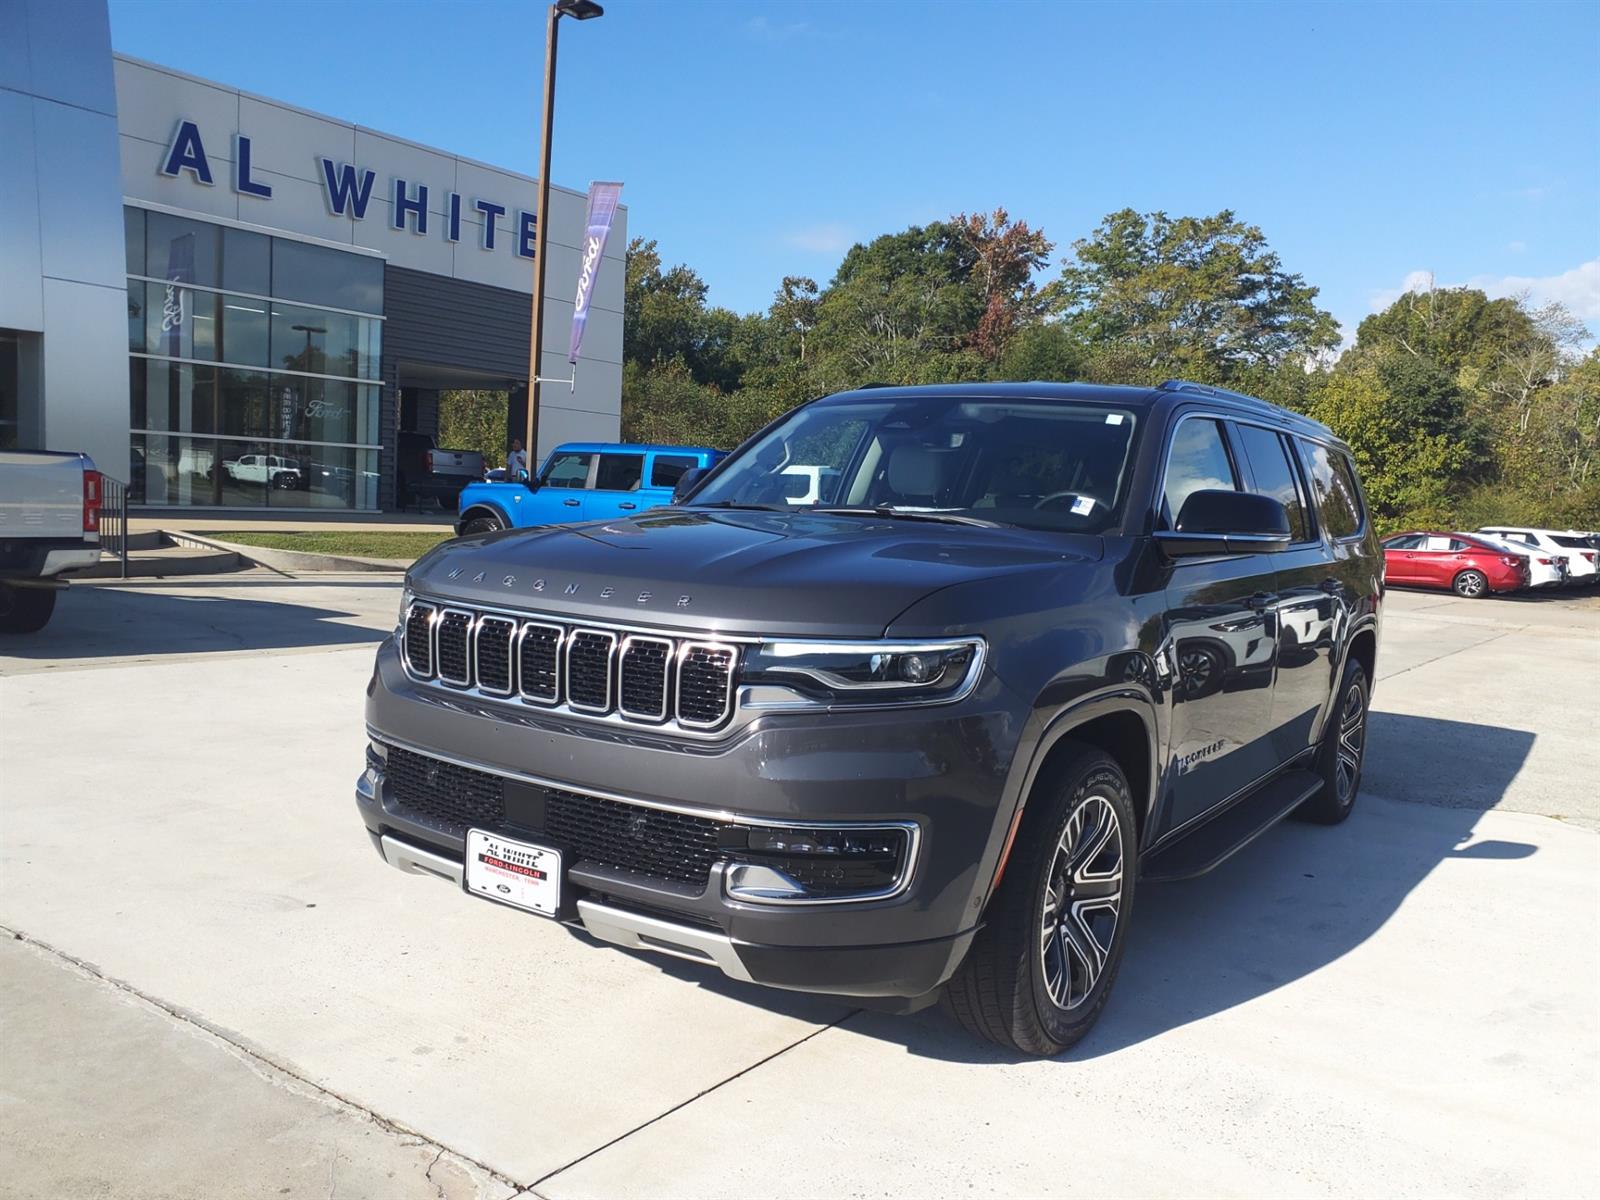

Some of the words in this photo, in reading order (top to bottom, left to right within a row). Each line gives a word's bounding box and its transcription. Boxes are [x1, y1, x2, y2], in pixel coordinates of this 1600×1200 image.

[162, 119, 272, 200] AL
[321, 157, 538, 260] WHITE
[305, 400, 344, 418] Ford
[448, 567, 693, 607] WAGONEER
[484, 856, 541, 878] FORD-LINCOLN
[486, 843, 499, 857] AL
[503, 847, 540, 868] WHITE
